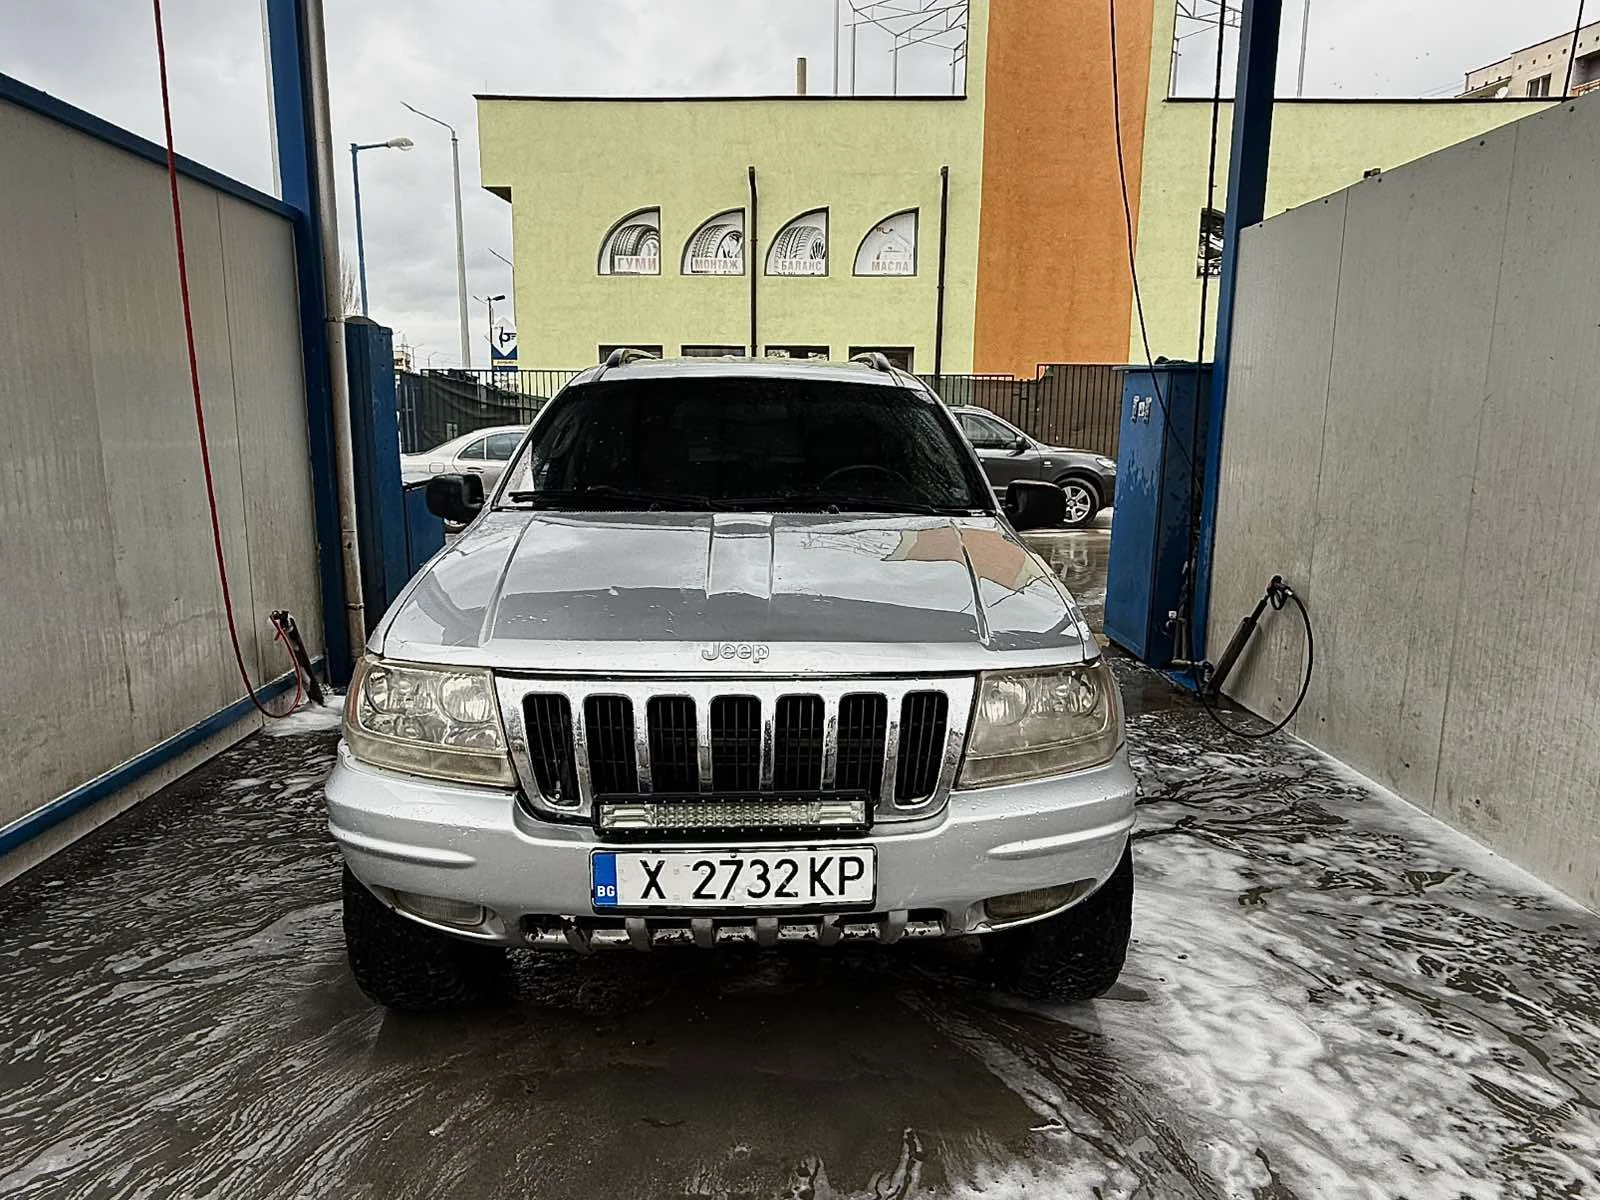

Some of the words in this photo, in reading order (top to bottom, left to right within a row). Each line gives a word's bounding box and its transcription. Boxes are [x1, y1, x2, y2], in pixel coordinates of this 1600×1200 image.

[616, 257, 657, 271] ГУМИ
[694, 259, 738, 270] МОНТАЖ
[781, 261, 822, 271] БАЛАНС
[871, 261, 909, 271] МАСЛА
[701, 642, 770, 664] Jeep
[639, 859, 667, 900] X
[691, 858, 800, 901] 2732
[809, 856, 865, 897] KP
[597, 885, 616, 897] BG
